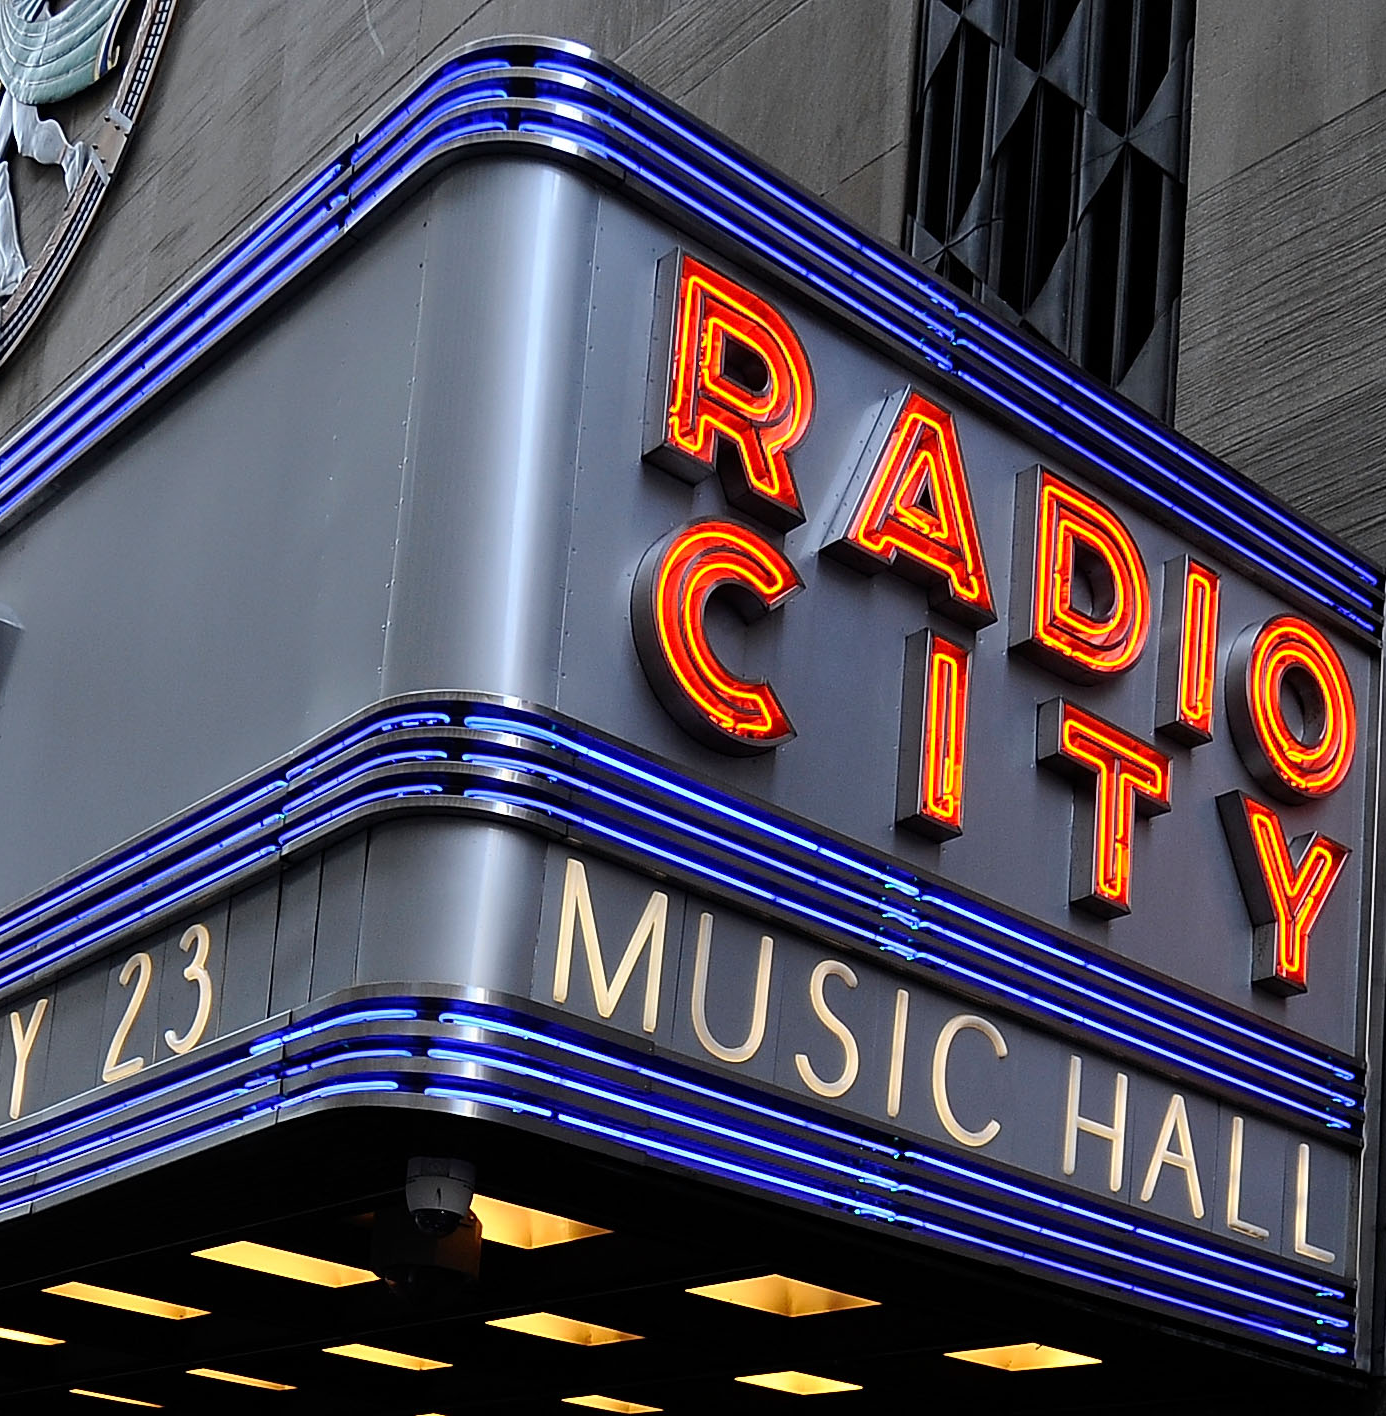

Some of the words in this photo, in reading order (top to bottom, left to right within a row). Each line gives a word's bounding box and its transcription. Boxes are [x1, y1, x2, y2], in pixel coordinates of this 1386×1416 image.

[649, 249, 1357, 800] RADIO
[635, 518, 1352, 995] CITY
[102, 922, 212, 1082] 23
[553, 858, 1010, 1147] MUSIC
[1063, 1054, 1336, 1263] HALL
